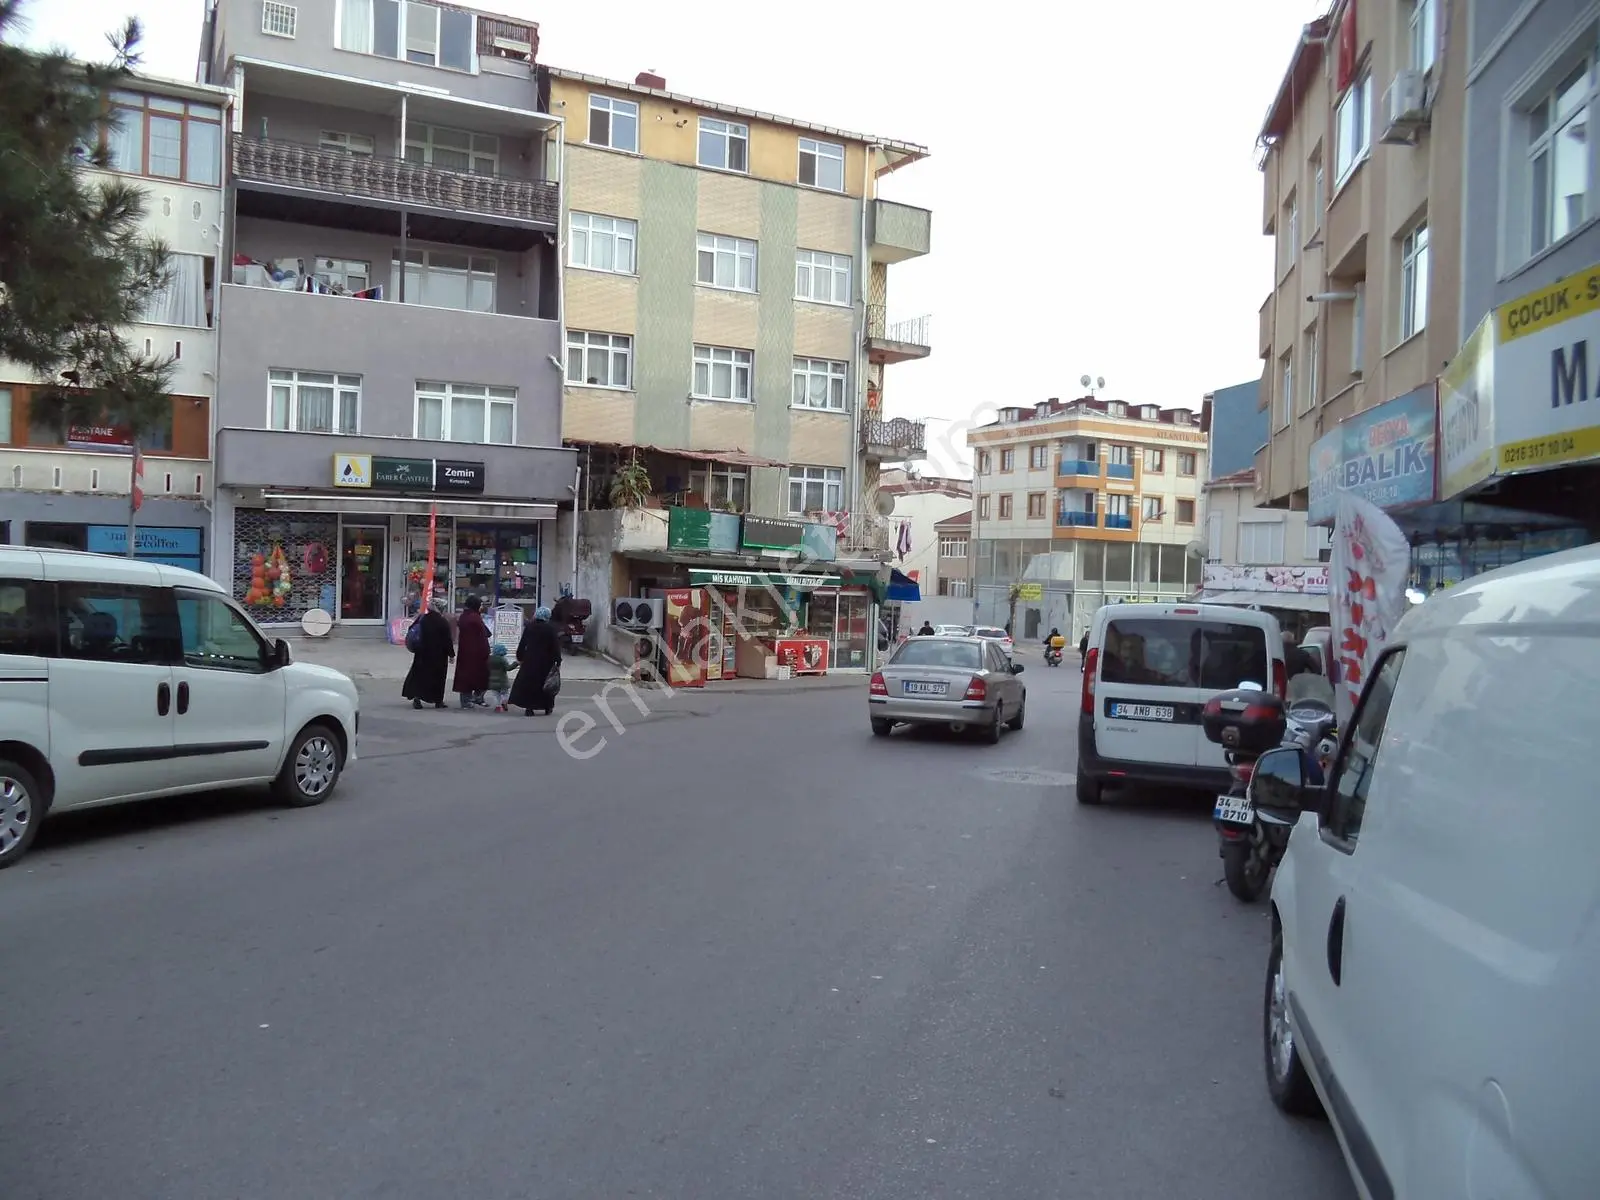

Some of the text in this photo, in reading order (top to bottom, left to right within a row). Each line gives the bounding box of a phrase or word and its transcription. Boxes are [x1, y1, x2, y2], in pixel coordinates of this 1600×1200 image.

[1507, 288, 1569, 335] ÇOCUK
[1527, 442, 1546, 458] 317
[1344, 441, 1426, 489] BALIK
[444, 467, 475, 478] Zemin
[711, 573, 752, 584] MİS KAHVALTI
[1117, 704, 1173, 718] 34 ANB 638
[1218, 797, 1231, 808] 34
[1223, 810, 1248, 822] 8710
